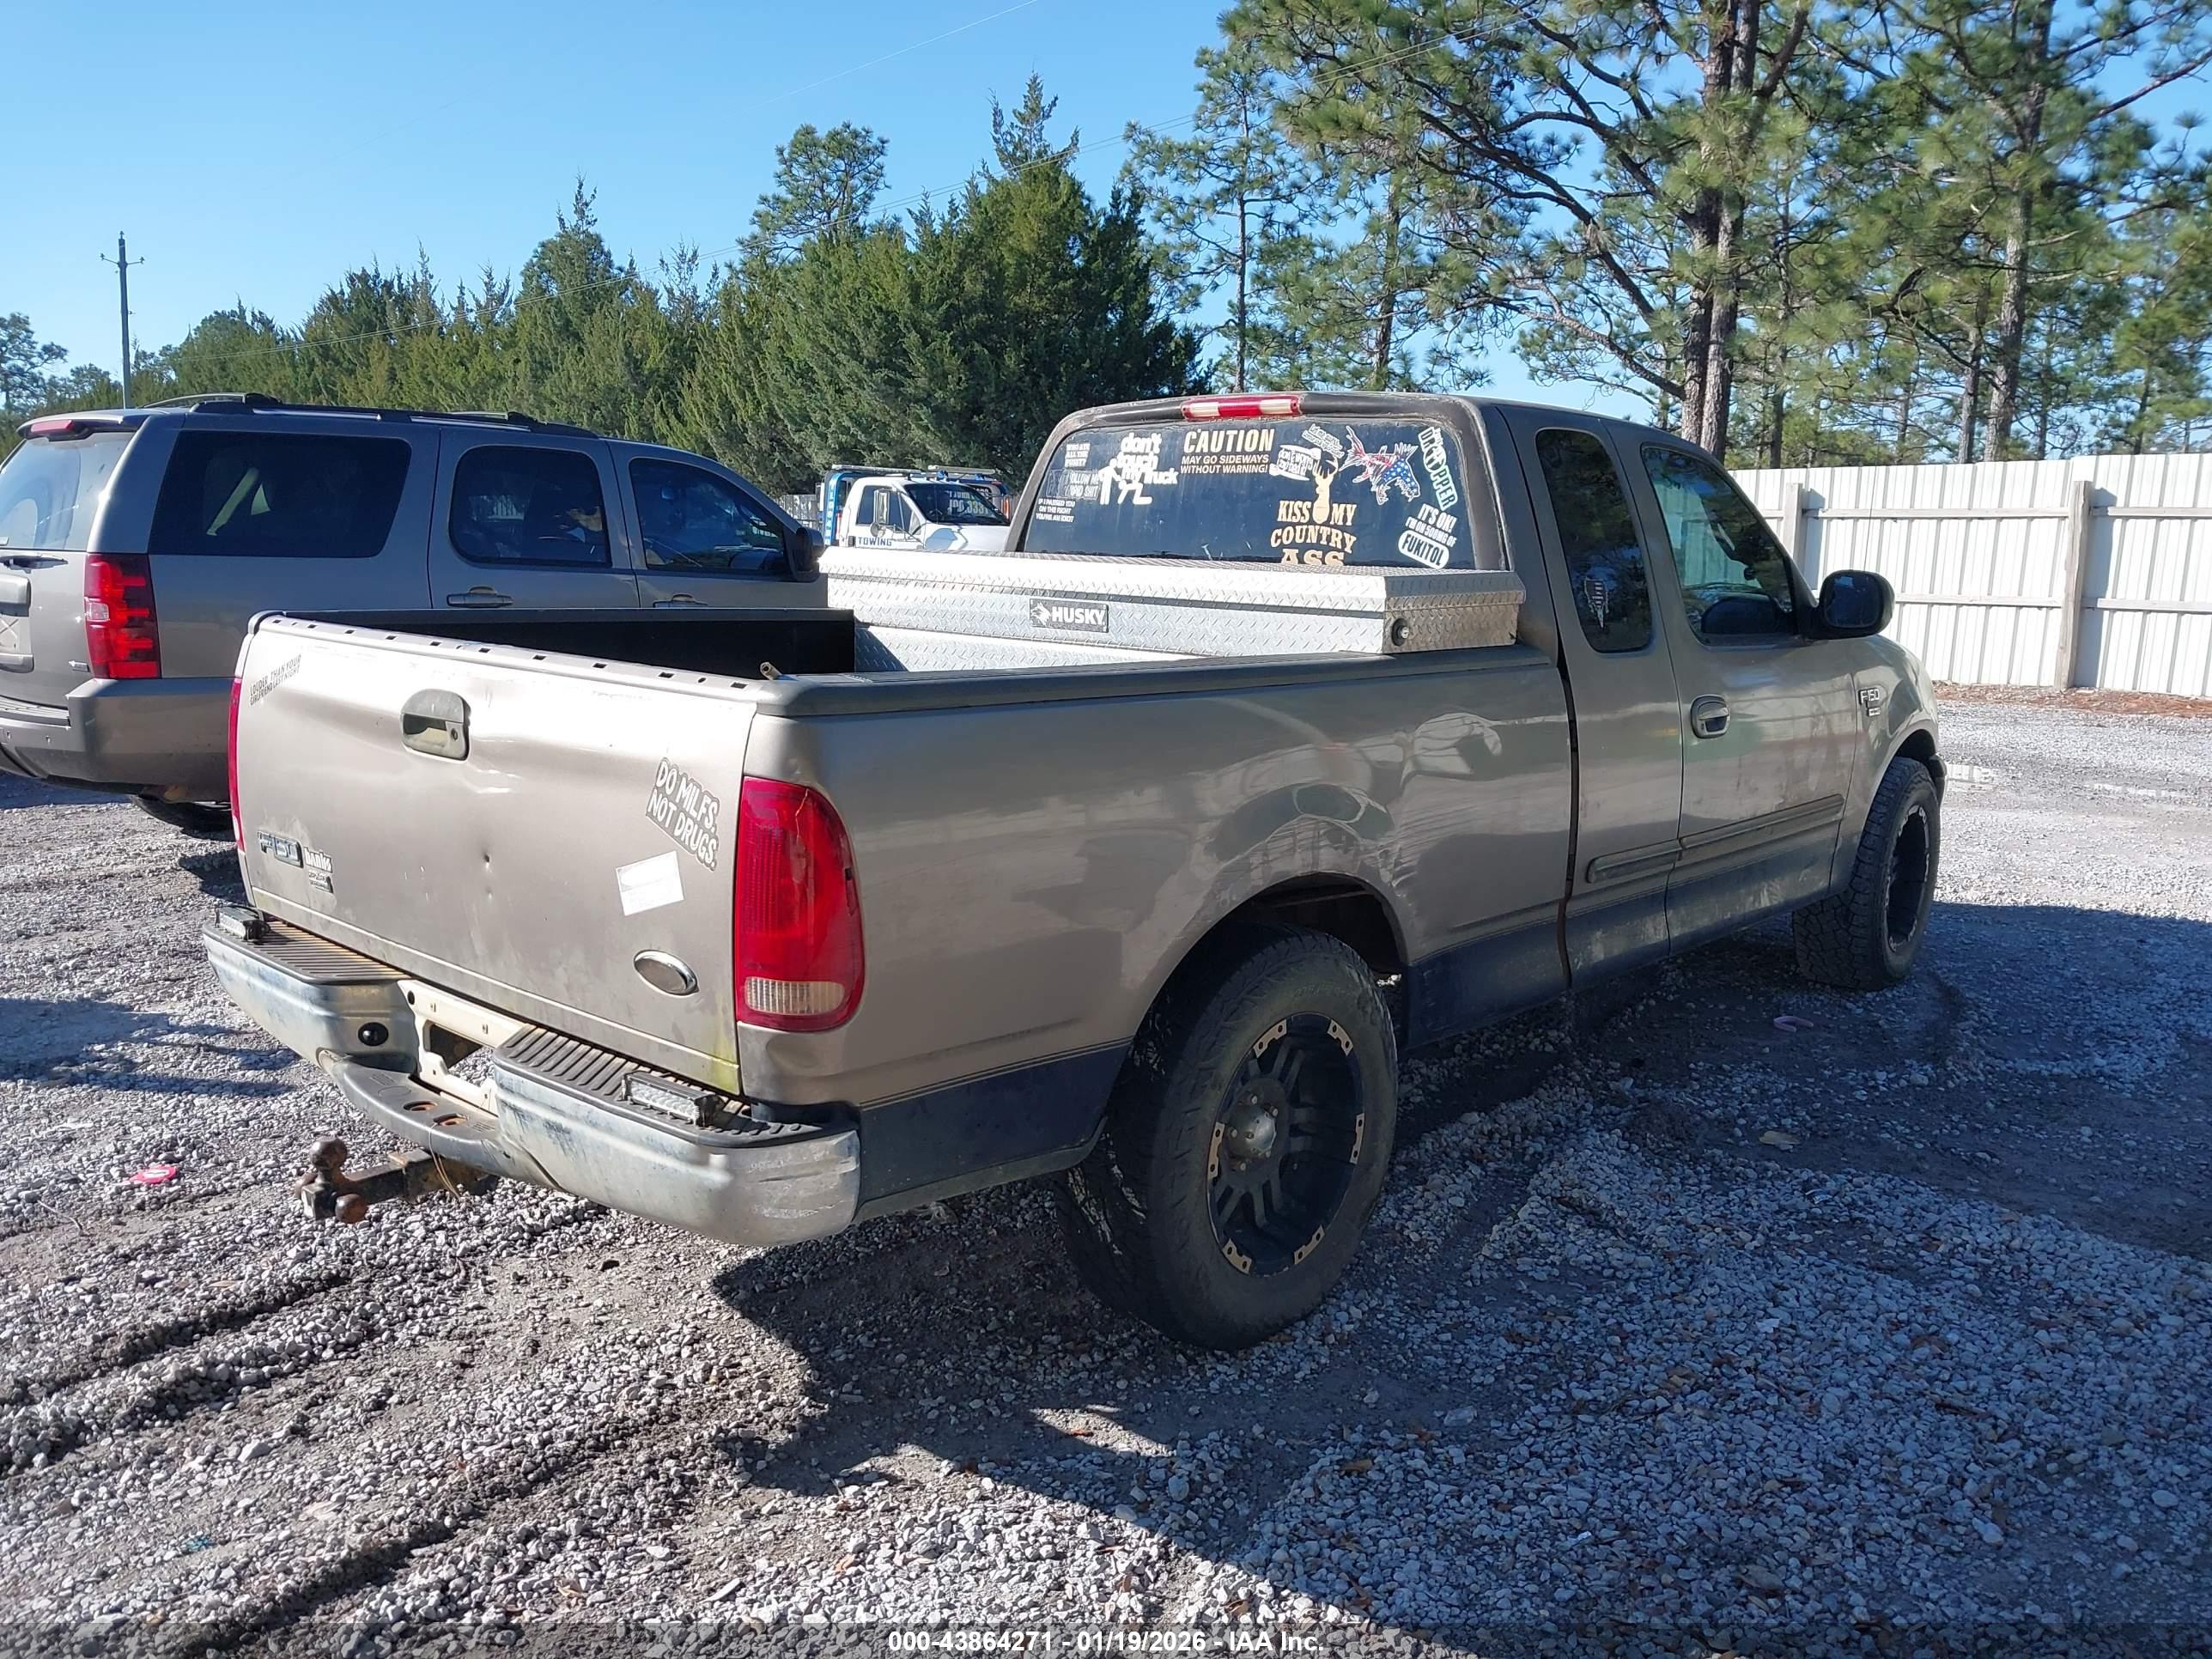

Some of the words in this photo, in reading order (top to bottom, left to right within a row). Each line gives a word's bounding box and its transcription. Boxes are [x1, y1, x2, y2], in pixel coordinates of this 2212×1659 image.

[1184, 428, 1275, 453] CAUTION
[1180, 465, 1221, 474] WITHOUT
[1222, 465, 1268, 474] WARNING!
[1182, 455, 1202, 465] MAY
[1203, 455, 1218, 465] GO
[1219, 454, 1270, 465] SIDEWAYS
[1277, 500, 1312, 523] KISS
[1329, 503, 1357, 526] MY
[1417, 503, 1439, 526] IT'S
[858, 537, 892, 546] TOWING
[1270, 525, 1358, 554] COUNTRY
[1401, 532, 1444, 567] FUKITOL
[1280, 548, 1346, 567] ASS
[1052, 606, 1106, 625] HUSKY
[250, 675, 269, 696] LOUDER
[270, 662, 285, 681] THAN
[286, 653, 301, 671] YOUR
[655, 760, 678, 795] DO
[675, 776, 718, 833] MILFS.
[647, 788, 677, 828] NOT
[674, 812, 718, 867] DRUGS.
